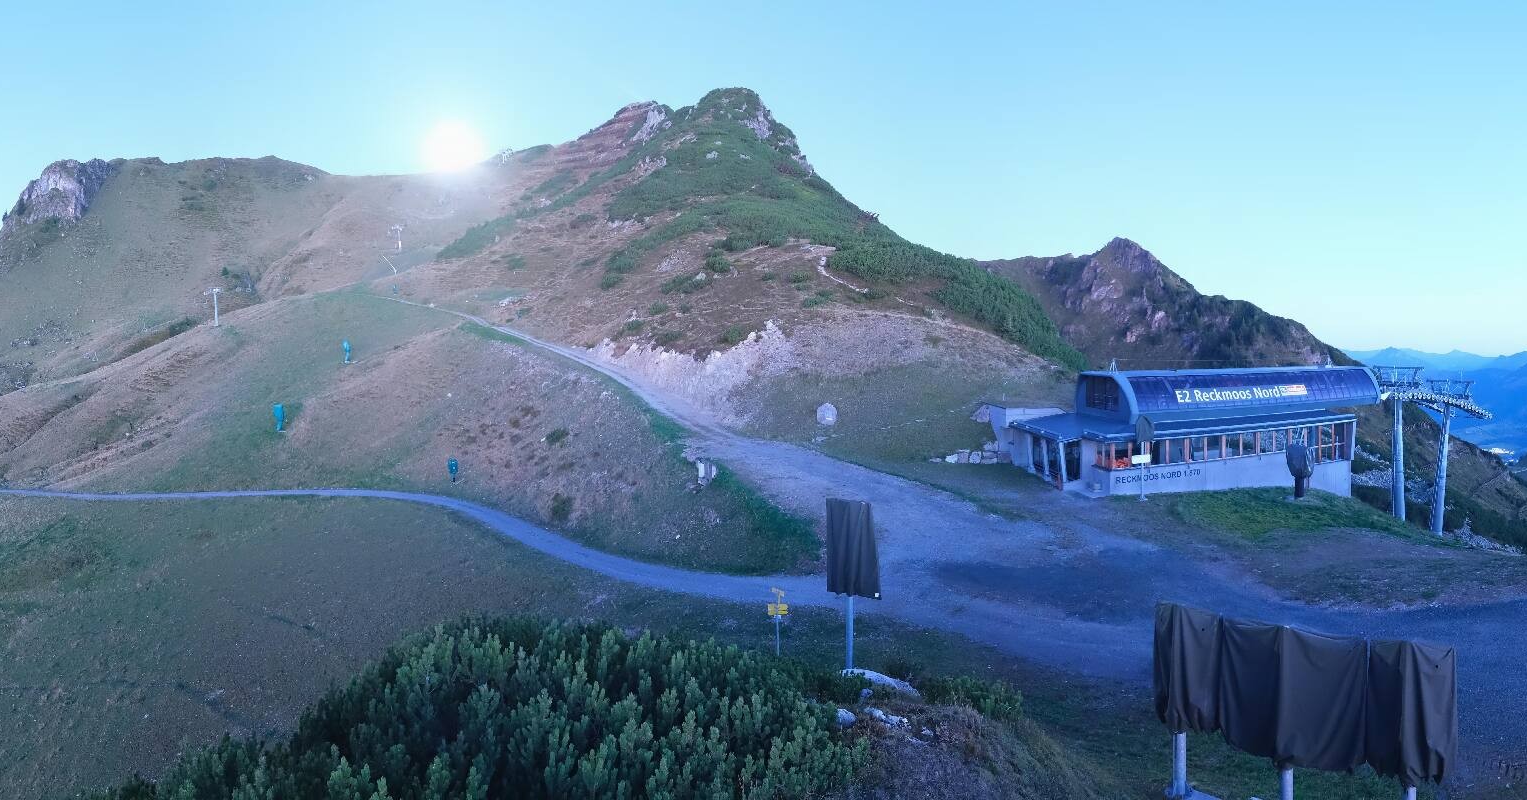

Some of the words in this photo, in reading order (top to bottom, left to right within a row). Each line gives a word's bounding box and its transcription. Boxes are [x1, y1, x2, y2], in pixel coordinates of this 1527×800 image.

[1175, 390, 1191, 402] E2
[1194, 388, 1252, 402] Reckmoos
[1253, 386, 1282, 399] Nord
[1161, 469, 1182, 480] NORD
